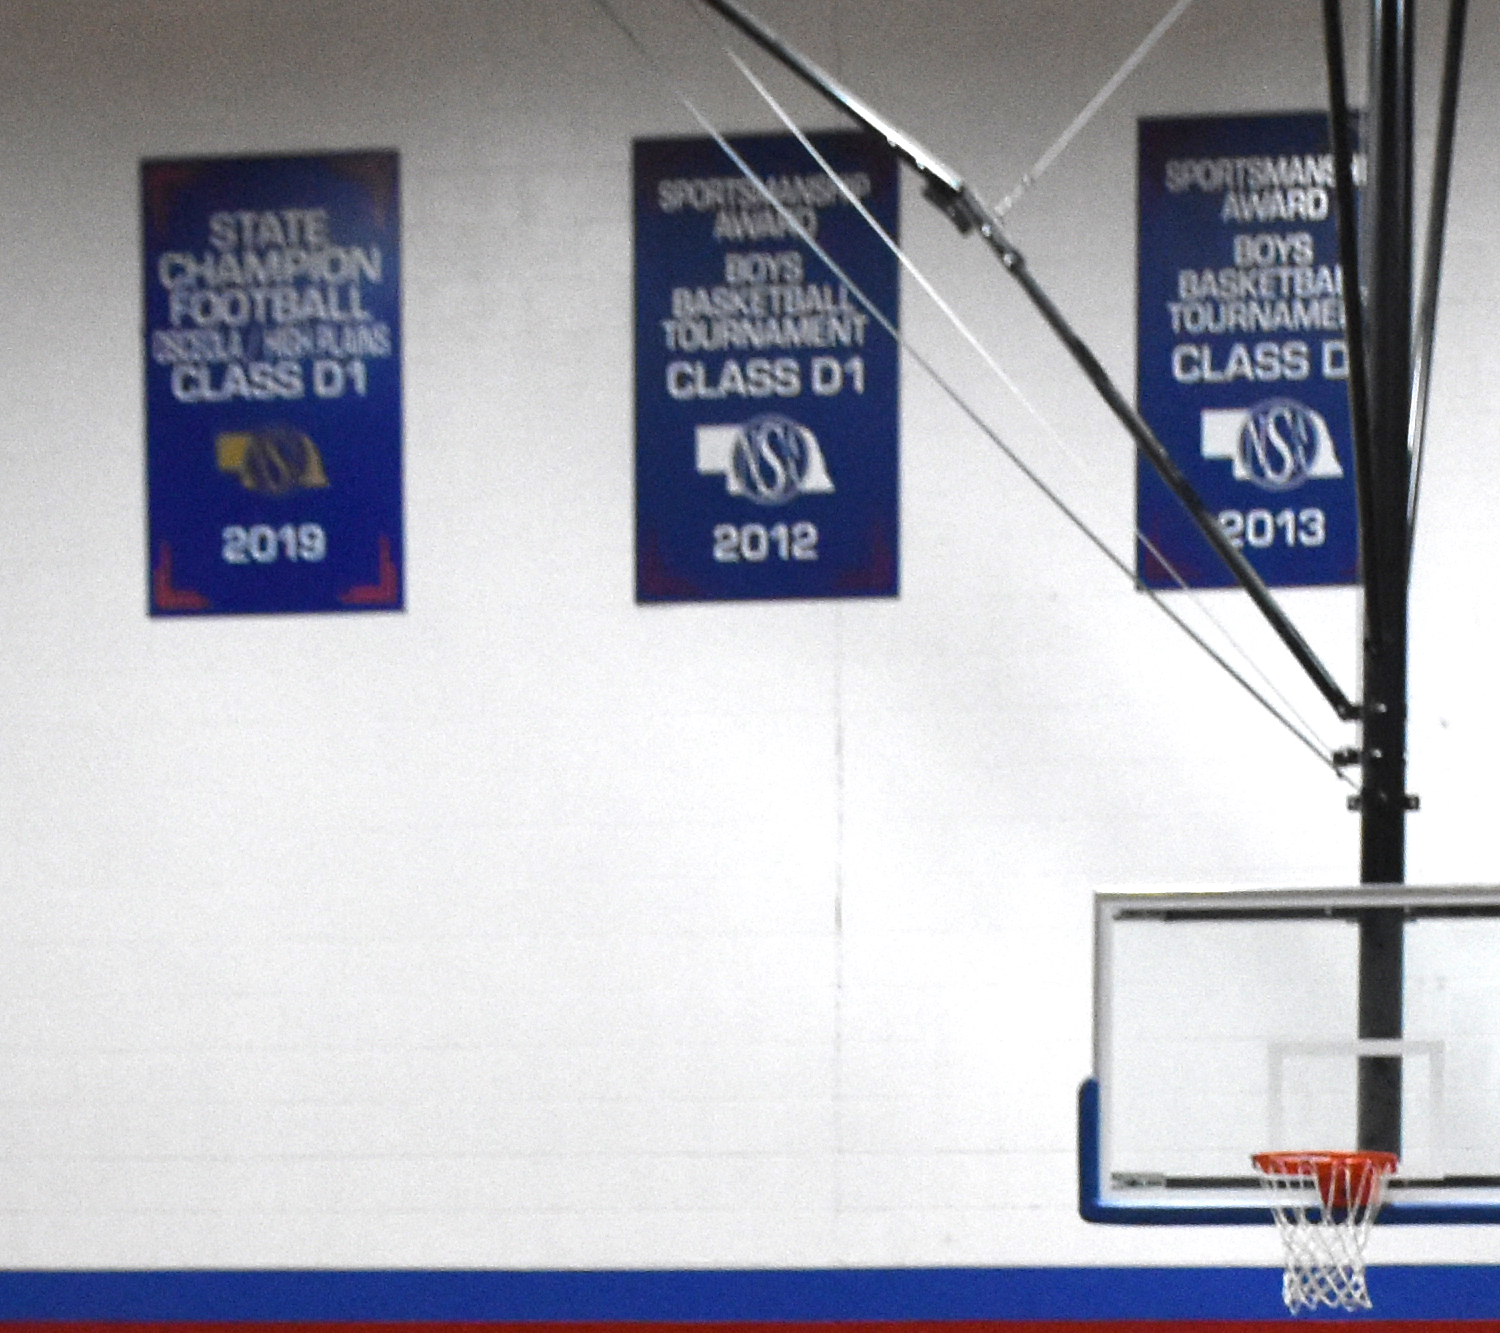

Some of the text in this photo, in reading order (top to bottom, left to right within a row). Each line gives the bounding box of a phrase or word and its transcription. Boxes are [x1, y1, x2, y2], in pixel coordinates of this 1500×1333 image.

[1220, 188, 1329, 223] AWARD
[208, 208, 329, 251] STATE
[1234, 232, 1314, 267] BOYS
[158, 245, 383, 291] CHAMPION
[724, 250, 804, 284] BOYS
[169, 284, 373, 328] FOOTBALL
[670, 284, 857, 319] BASKETBALL
[661, 313, 868, 350] TOURNAMENT
[171, 360, 367, 402] CLASS D1
[666, 355, 865, 399] CLASS D1
[1172, 338, 1351, 384] CLASS D
[221, 522, 327, 564] 2019
[712, 523, 819, 563] 2012
[1216, 509, 1326, 548] 2013
